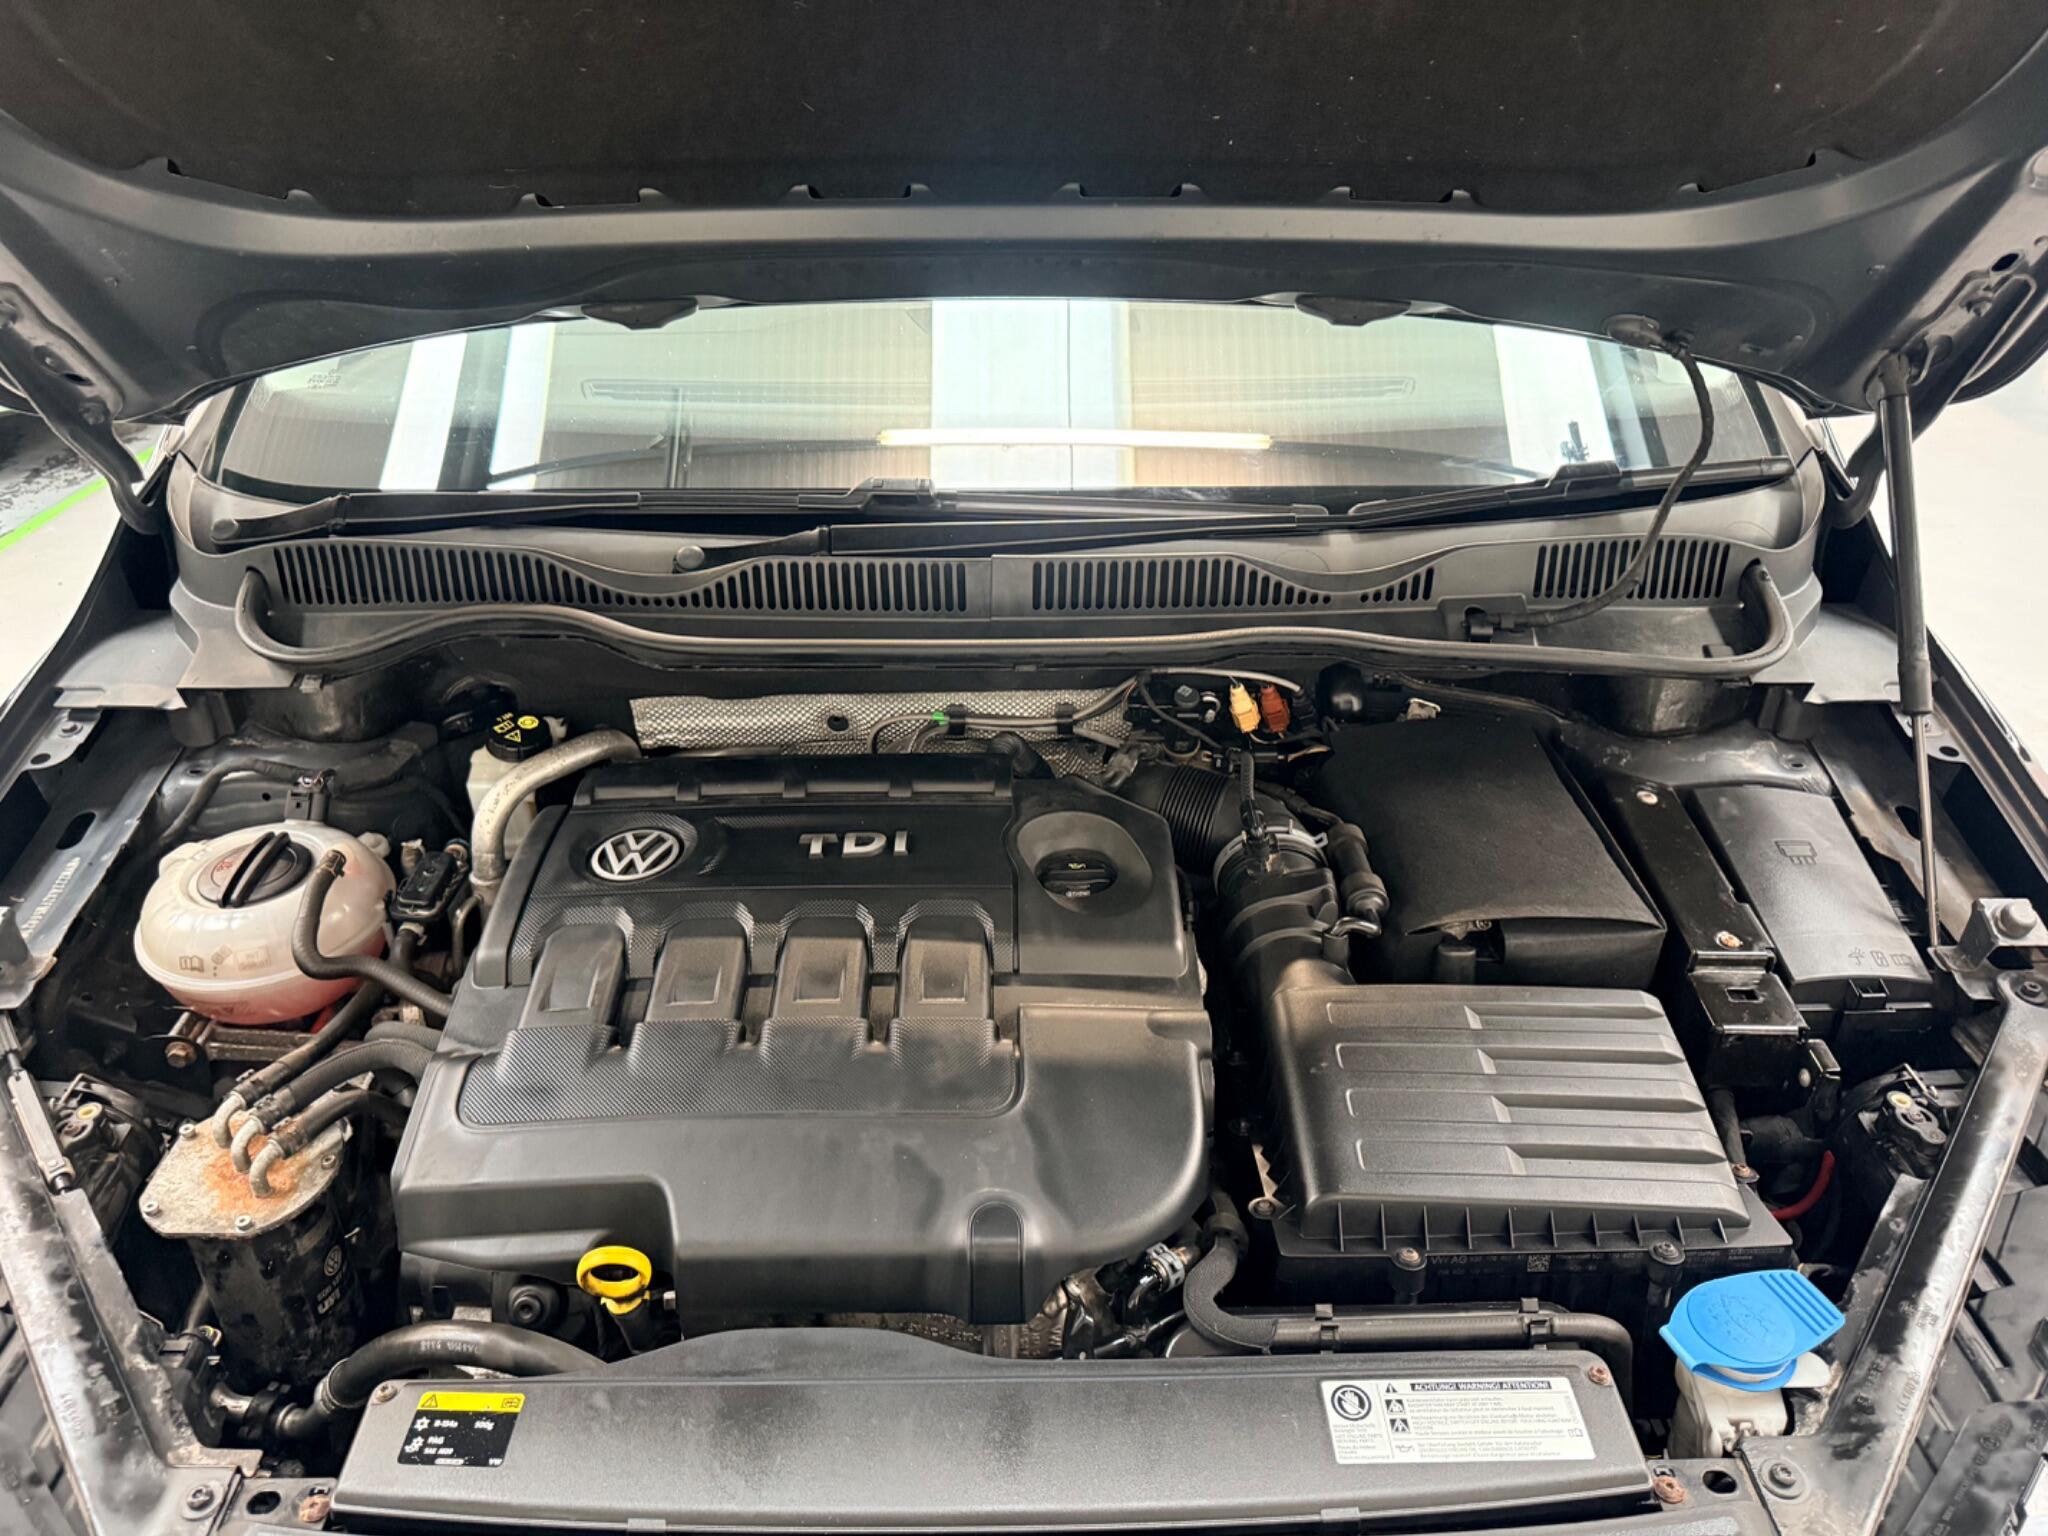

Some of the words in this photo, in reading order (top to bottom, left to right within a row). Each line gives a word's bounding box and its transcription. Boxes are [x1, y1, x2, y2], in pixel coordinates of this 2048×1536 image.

[799, 830, 909, 860] TDI
[1413, 1382, 1456, 1391] ACHTUNG!
[1458, 1381, 1500, 1391] WARNING!
[1502, 1381, 1549, 1390] ATTENTION!
